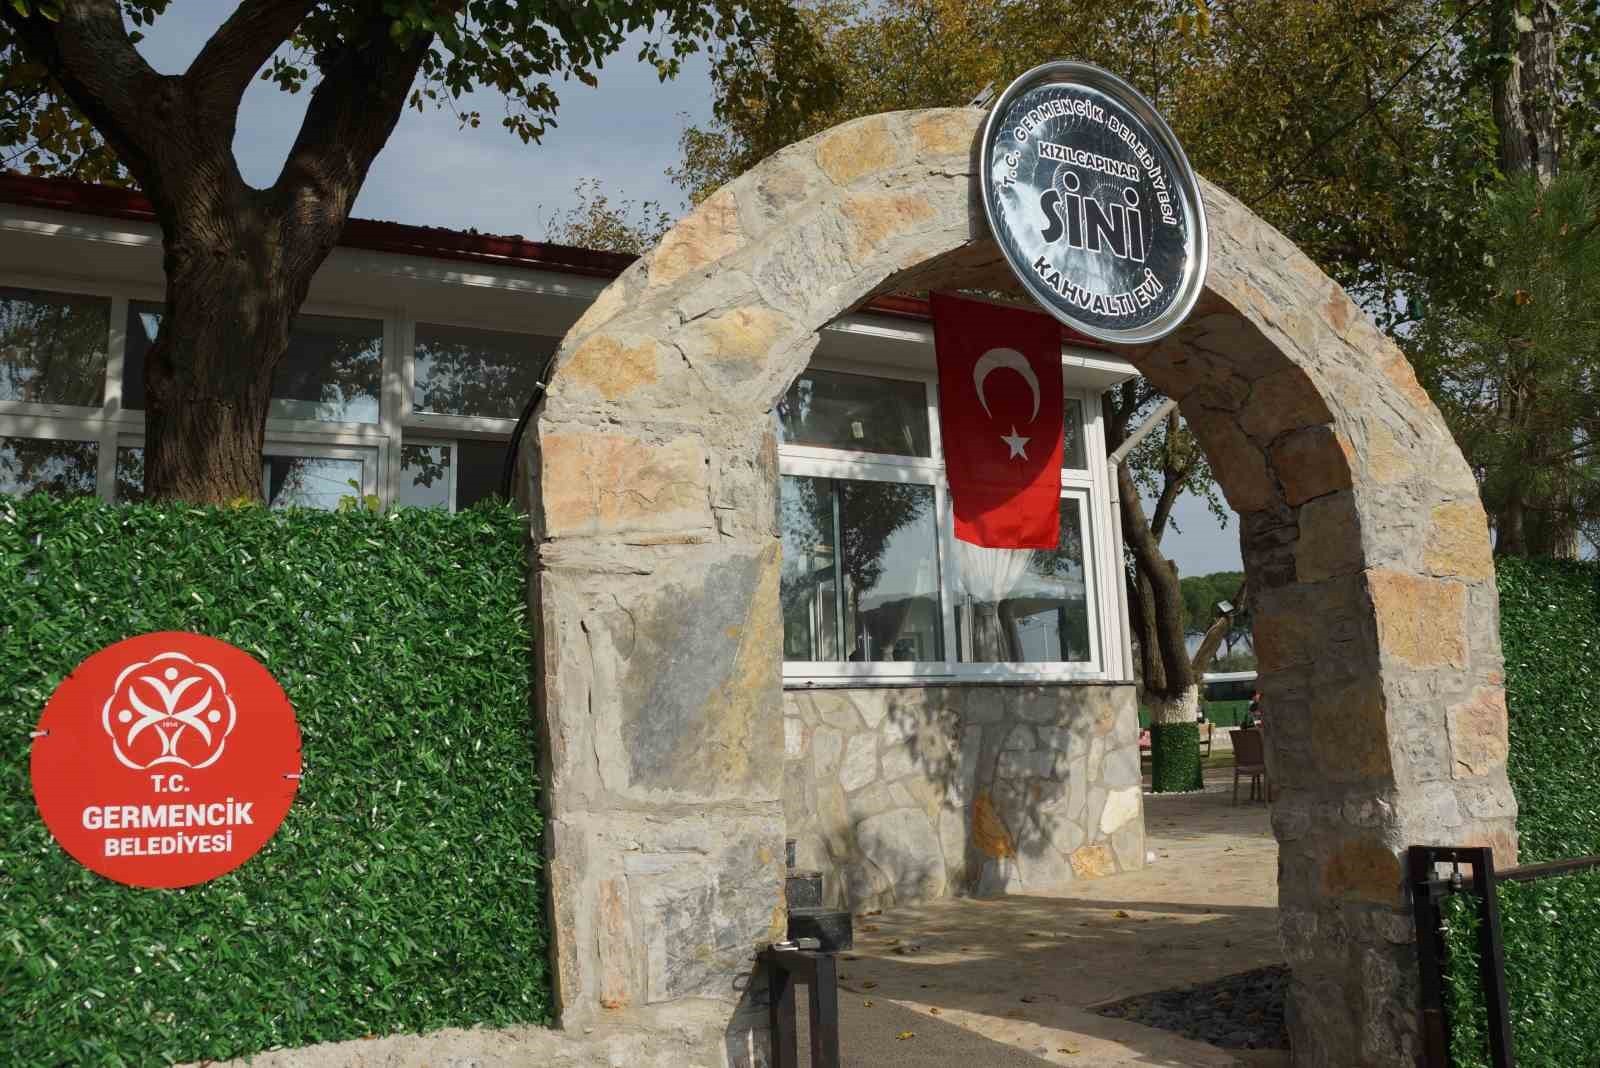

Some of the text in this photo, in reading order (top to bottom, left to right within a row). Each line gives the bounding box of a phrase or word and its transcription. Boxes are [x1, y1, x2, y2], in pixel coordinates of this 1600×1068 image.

[1003, 149, 1021, 188] T.C.
[1014, 99, 1104, 143] GERMENCİK
[1038, 141, 1140, 182] KIZILCAPINAR
[1039, 171, 1145, 262] SİNİ
[1033, 255, 1163, 316] KAHVALTI EVİ
[151, 774, 190, 793] T.C.
[82, 797, 254, 830] GERMENCİK
[104, 830, 233, 857] BELEDİYESİ
